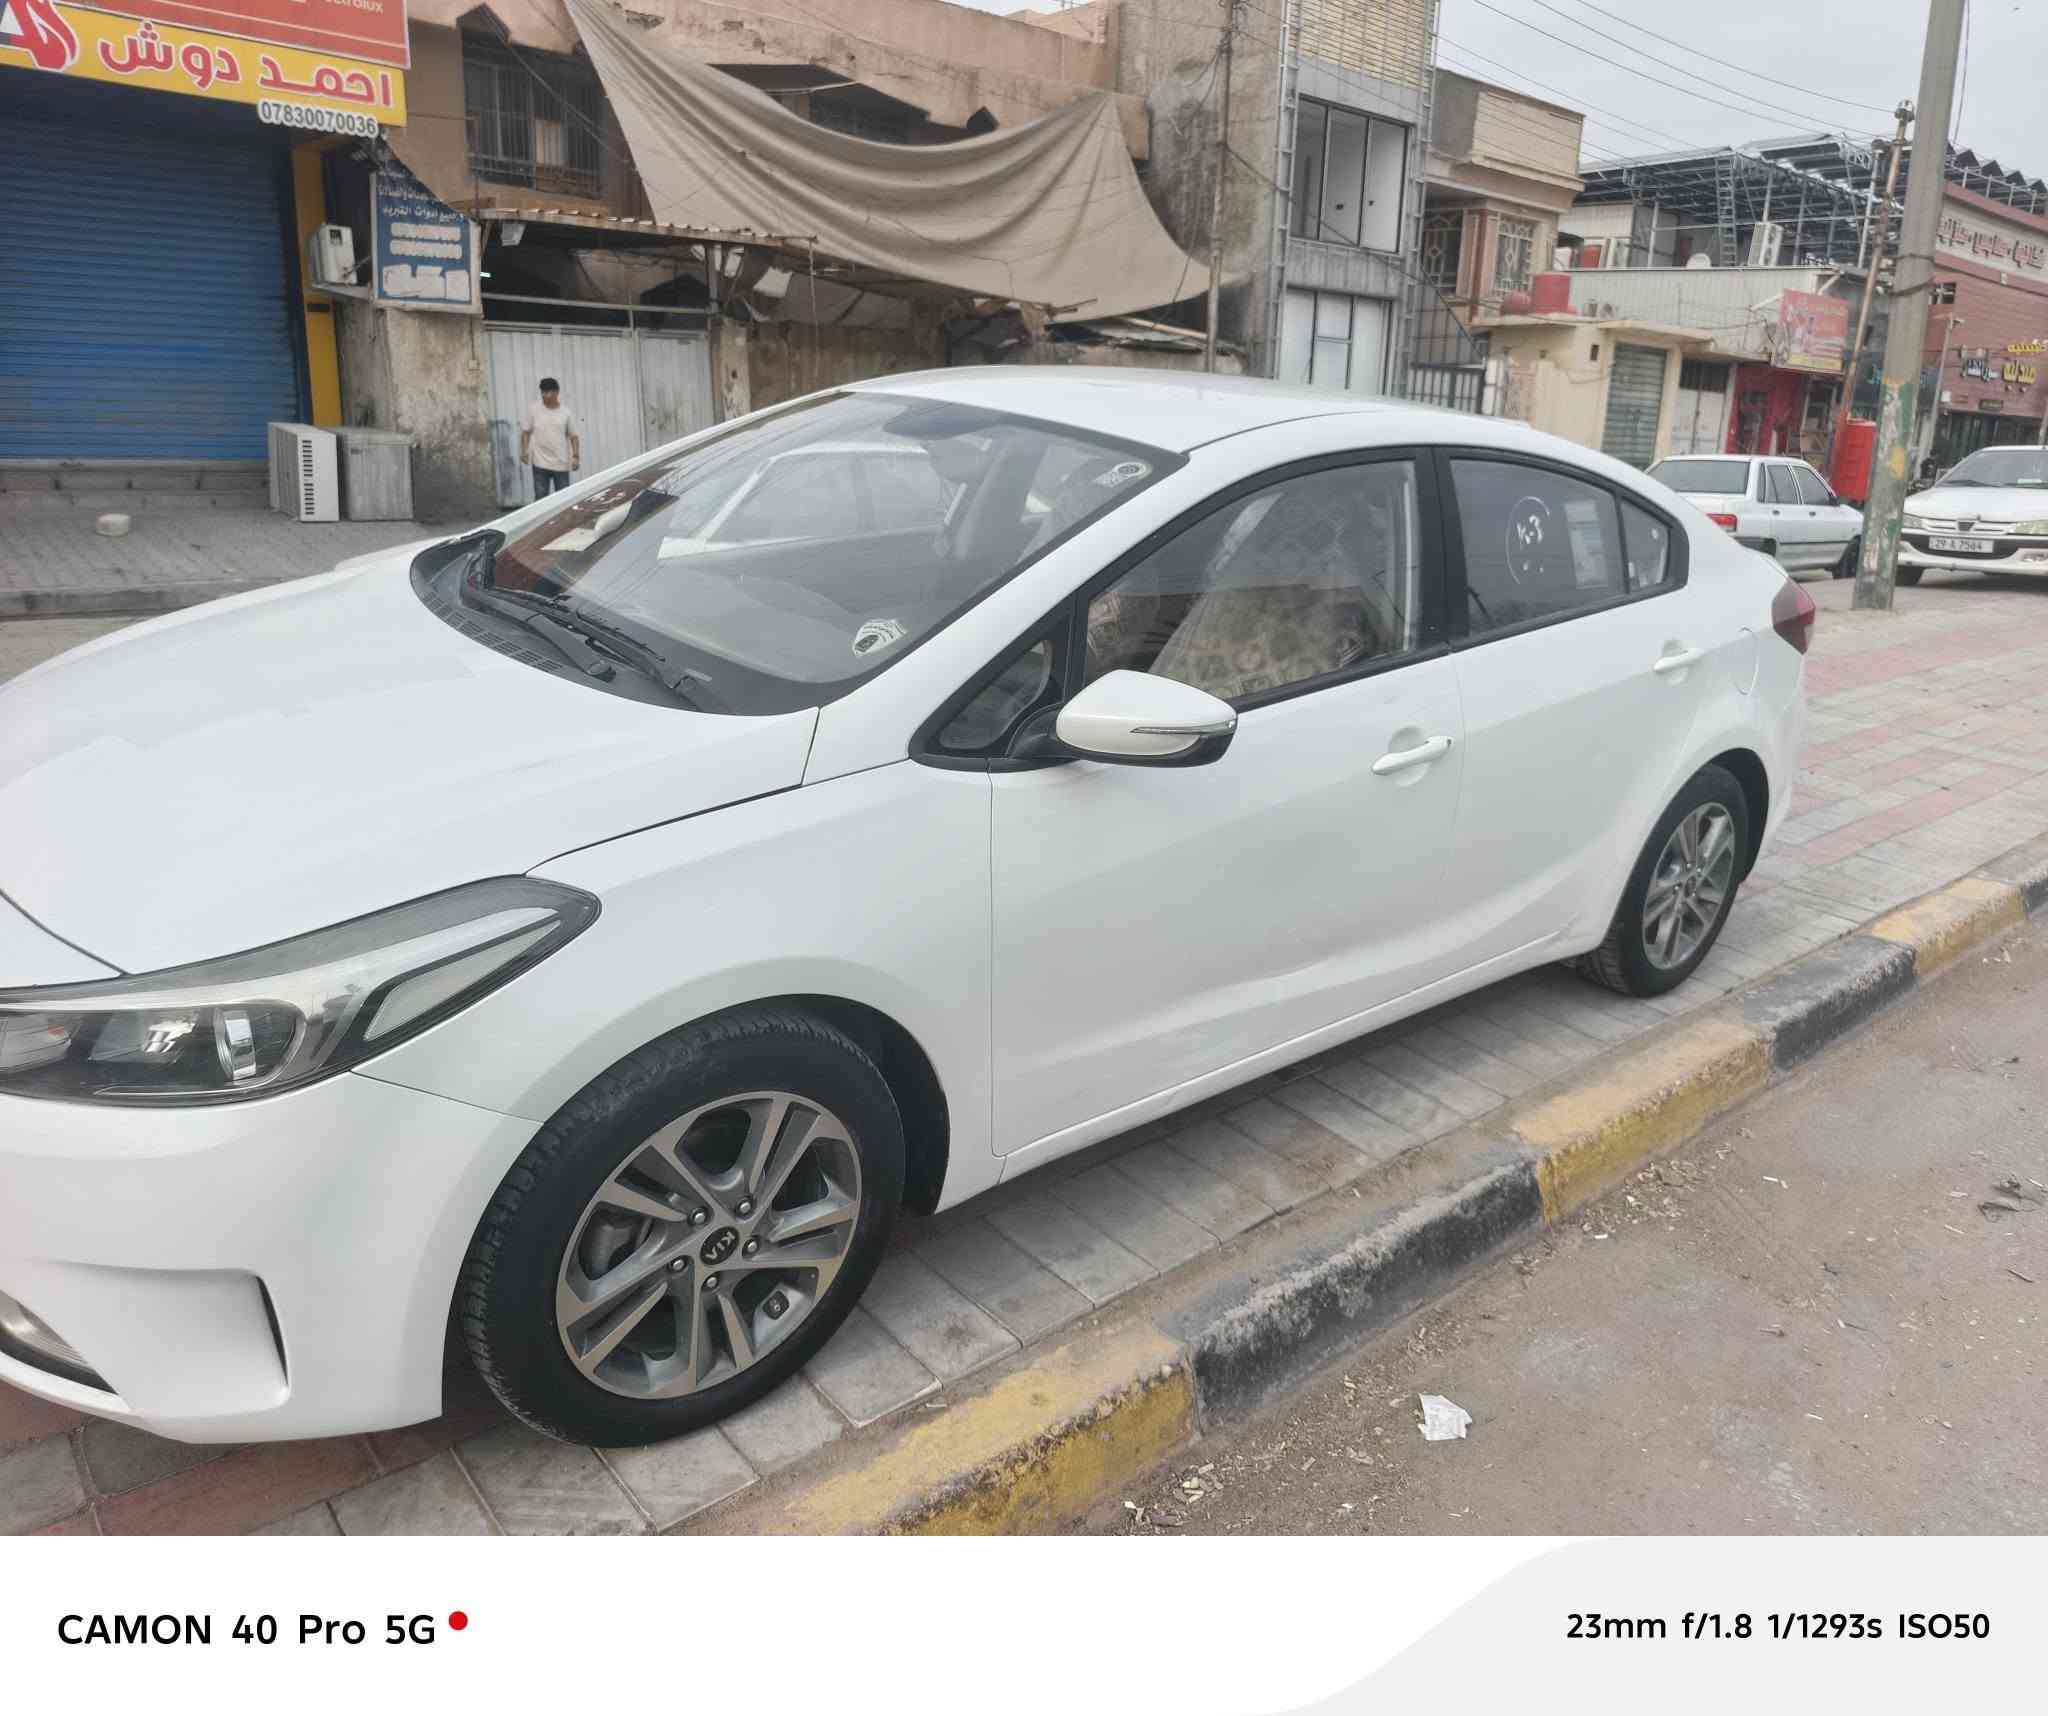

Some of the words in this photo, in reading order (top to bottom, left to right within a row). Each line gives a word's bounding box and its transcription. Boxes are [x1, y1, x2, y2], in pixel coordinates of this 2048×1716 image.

[98, 19, 242, 90] دوش
[259, 54, 391, 107] احمد
[259, 100, 378, 136] 07830070036
[705, 1231, 736, 1260] KIA
